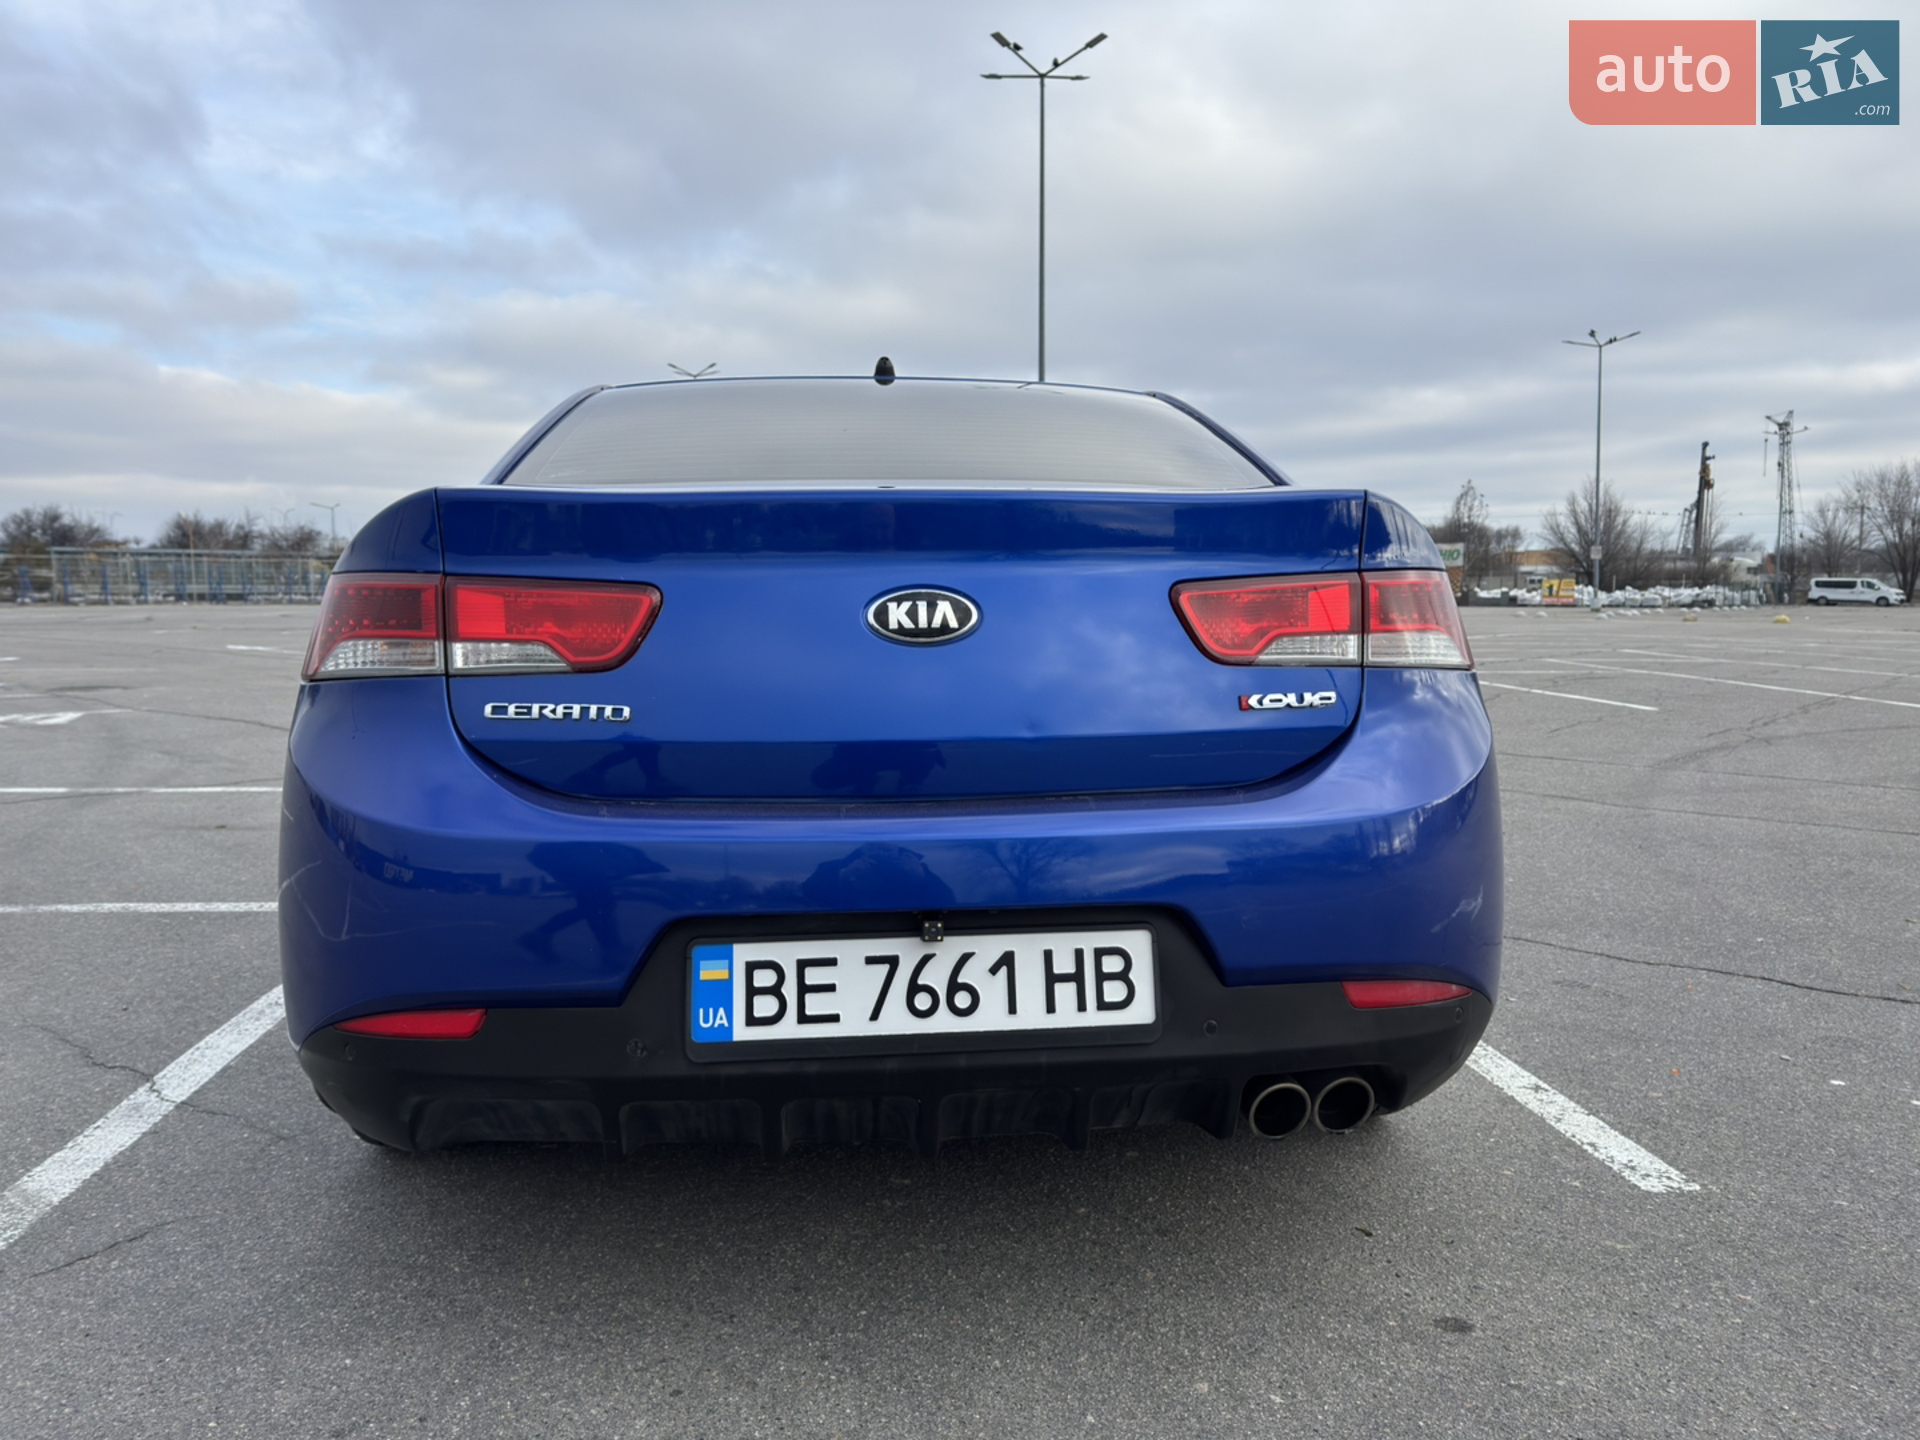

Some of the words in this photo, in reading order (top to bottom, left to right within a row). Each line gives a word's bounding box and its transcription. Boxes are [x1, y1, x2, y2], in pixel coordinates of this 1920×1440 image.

[886, 600, 959, 629] KIA
[1239, 691, 1336, 711] KOUP
[484, 702, 631, 721] CERATO
[744, 957, 841, 1027] BE
[864, 950, 1018, 1022] 7661
[1043, 946, 1136, 1014] HB
[699, 1008, 729, 1028] UA
